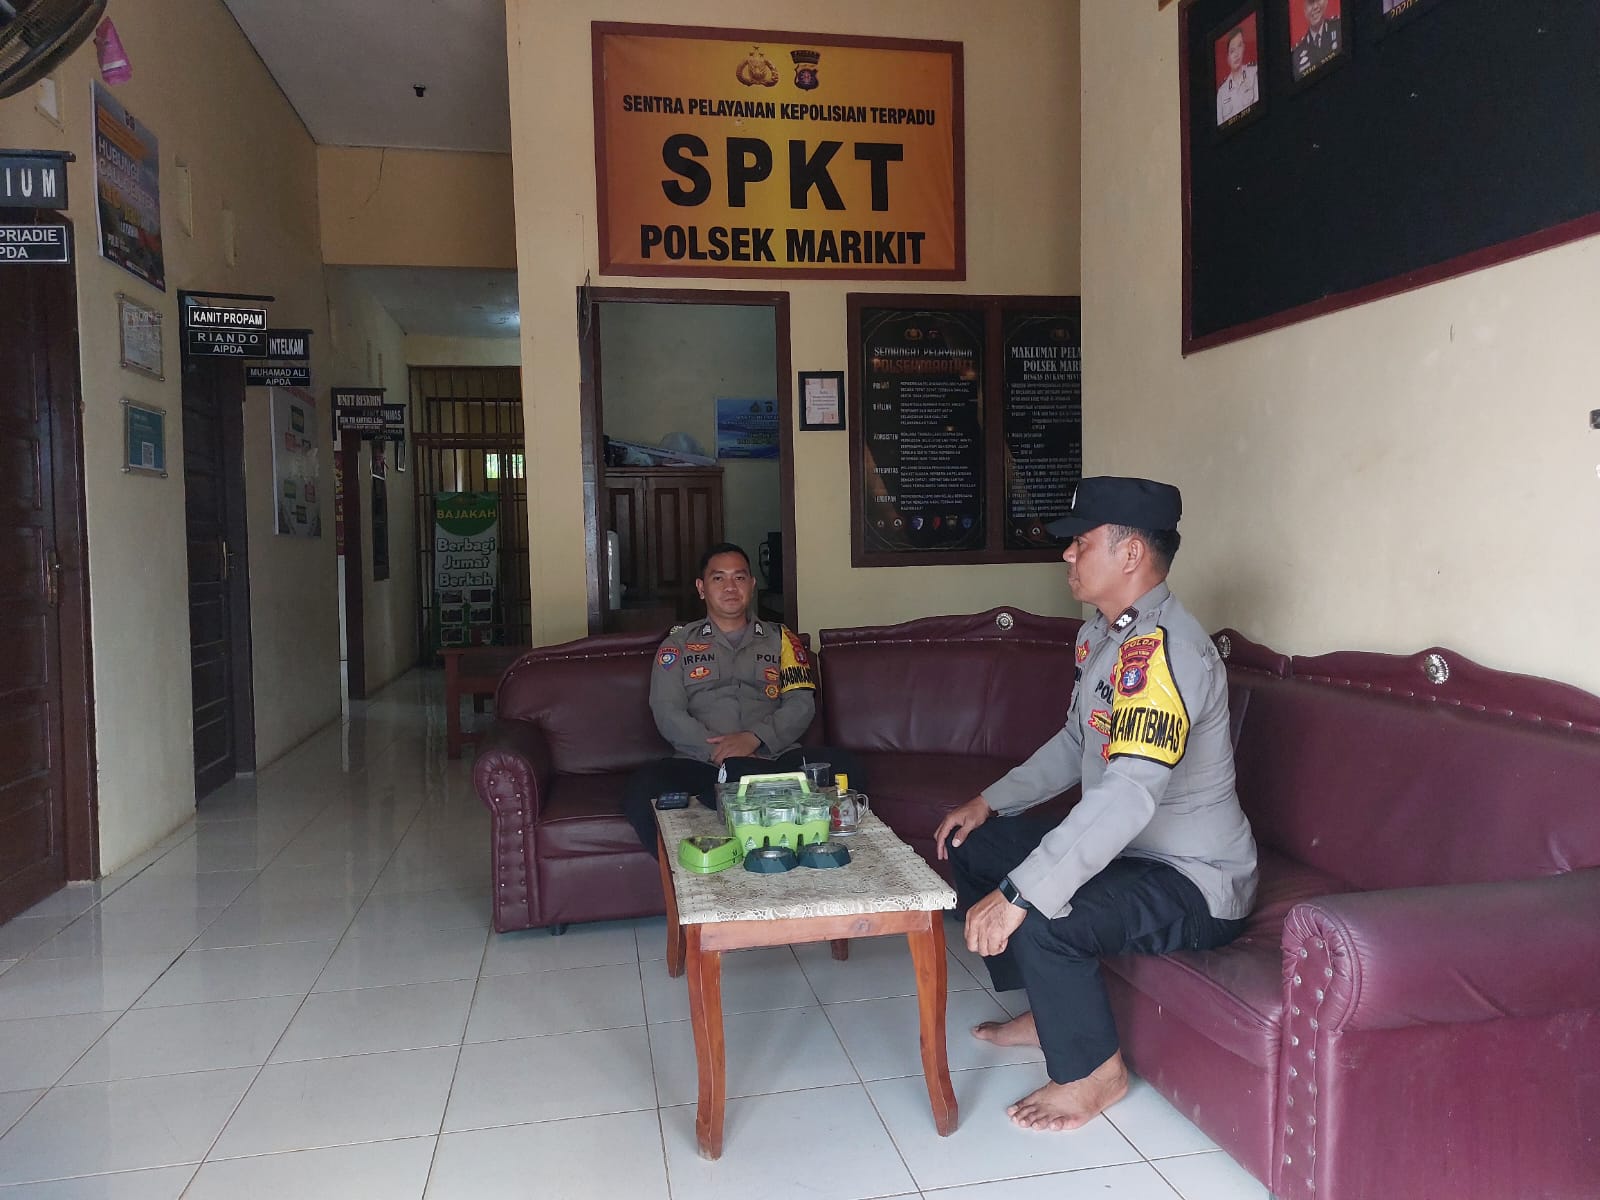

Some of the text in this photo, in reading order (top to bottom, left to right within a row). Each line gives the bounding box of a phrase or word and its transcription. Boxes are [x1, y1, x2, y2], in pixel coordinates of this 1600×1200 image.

[623, 94, 935, 126] SENTRA PELAYANAN KEPOLISIAN TERPADU
[661, 133, 903, 211] SPKT
[640, 224, 925, 264] POLSEK MARIKIT
[193, 311, 263, 326] KANIT PROPAM
[197, 332, 259, 344] RIANDO
[212, 344, 244, 354] AIPDA
[269, 338, 304, 355] INTELKAM
[1011, 346, 1057, 359] MAKLUMAT
[250, 368, 291, 377] MUHAMAD
[1023, 360, 1057, 372] POLSEK
[265, 378, 292, 386] AIPDA
[436, 509, 497, 519] BAJAKAH
[437, 536, 496, 555] Berbagi
[443, 556, 490, 570] Jumat
[439, 572, 493, 587] Berkah
[1124, 639, 1155, 651] POLDA
[684, 653, 715, 666] IRFAN
